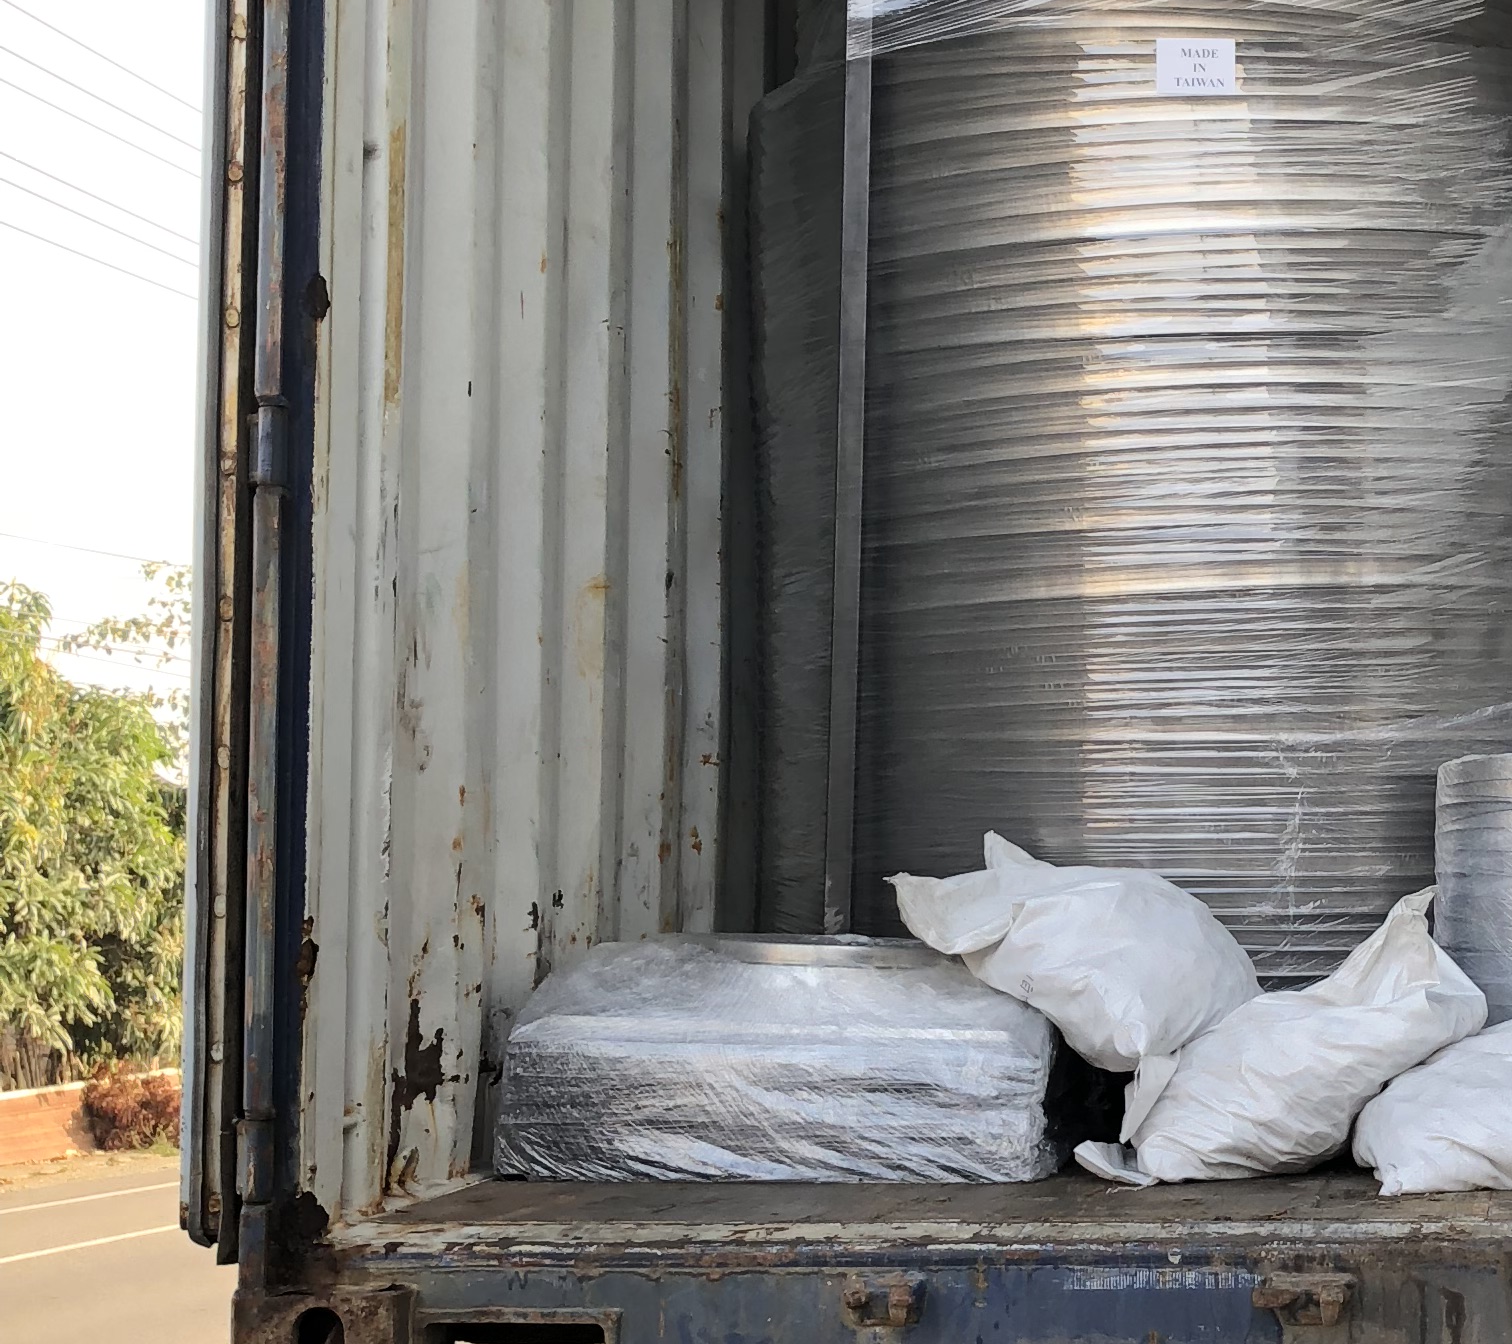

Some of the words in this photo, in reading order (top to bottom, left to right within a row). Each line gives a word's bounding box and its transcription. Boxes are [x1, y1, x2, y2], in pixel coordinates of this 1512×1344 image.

[1180, 47, 1219, 59] MADE
[1193, 62, 1206, 73] IN
[1174, 76, 1225, 88] TAIWAN
